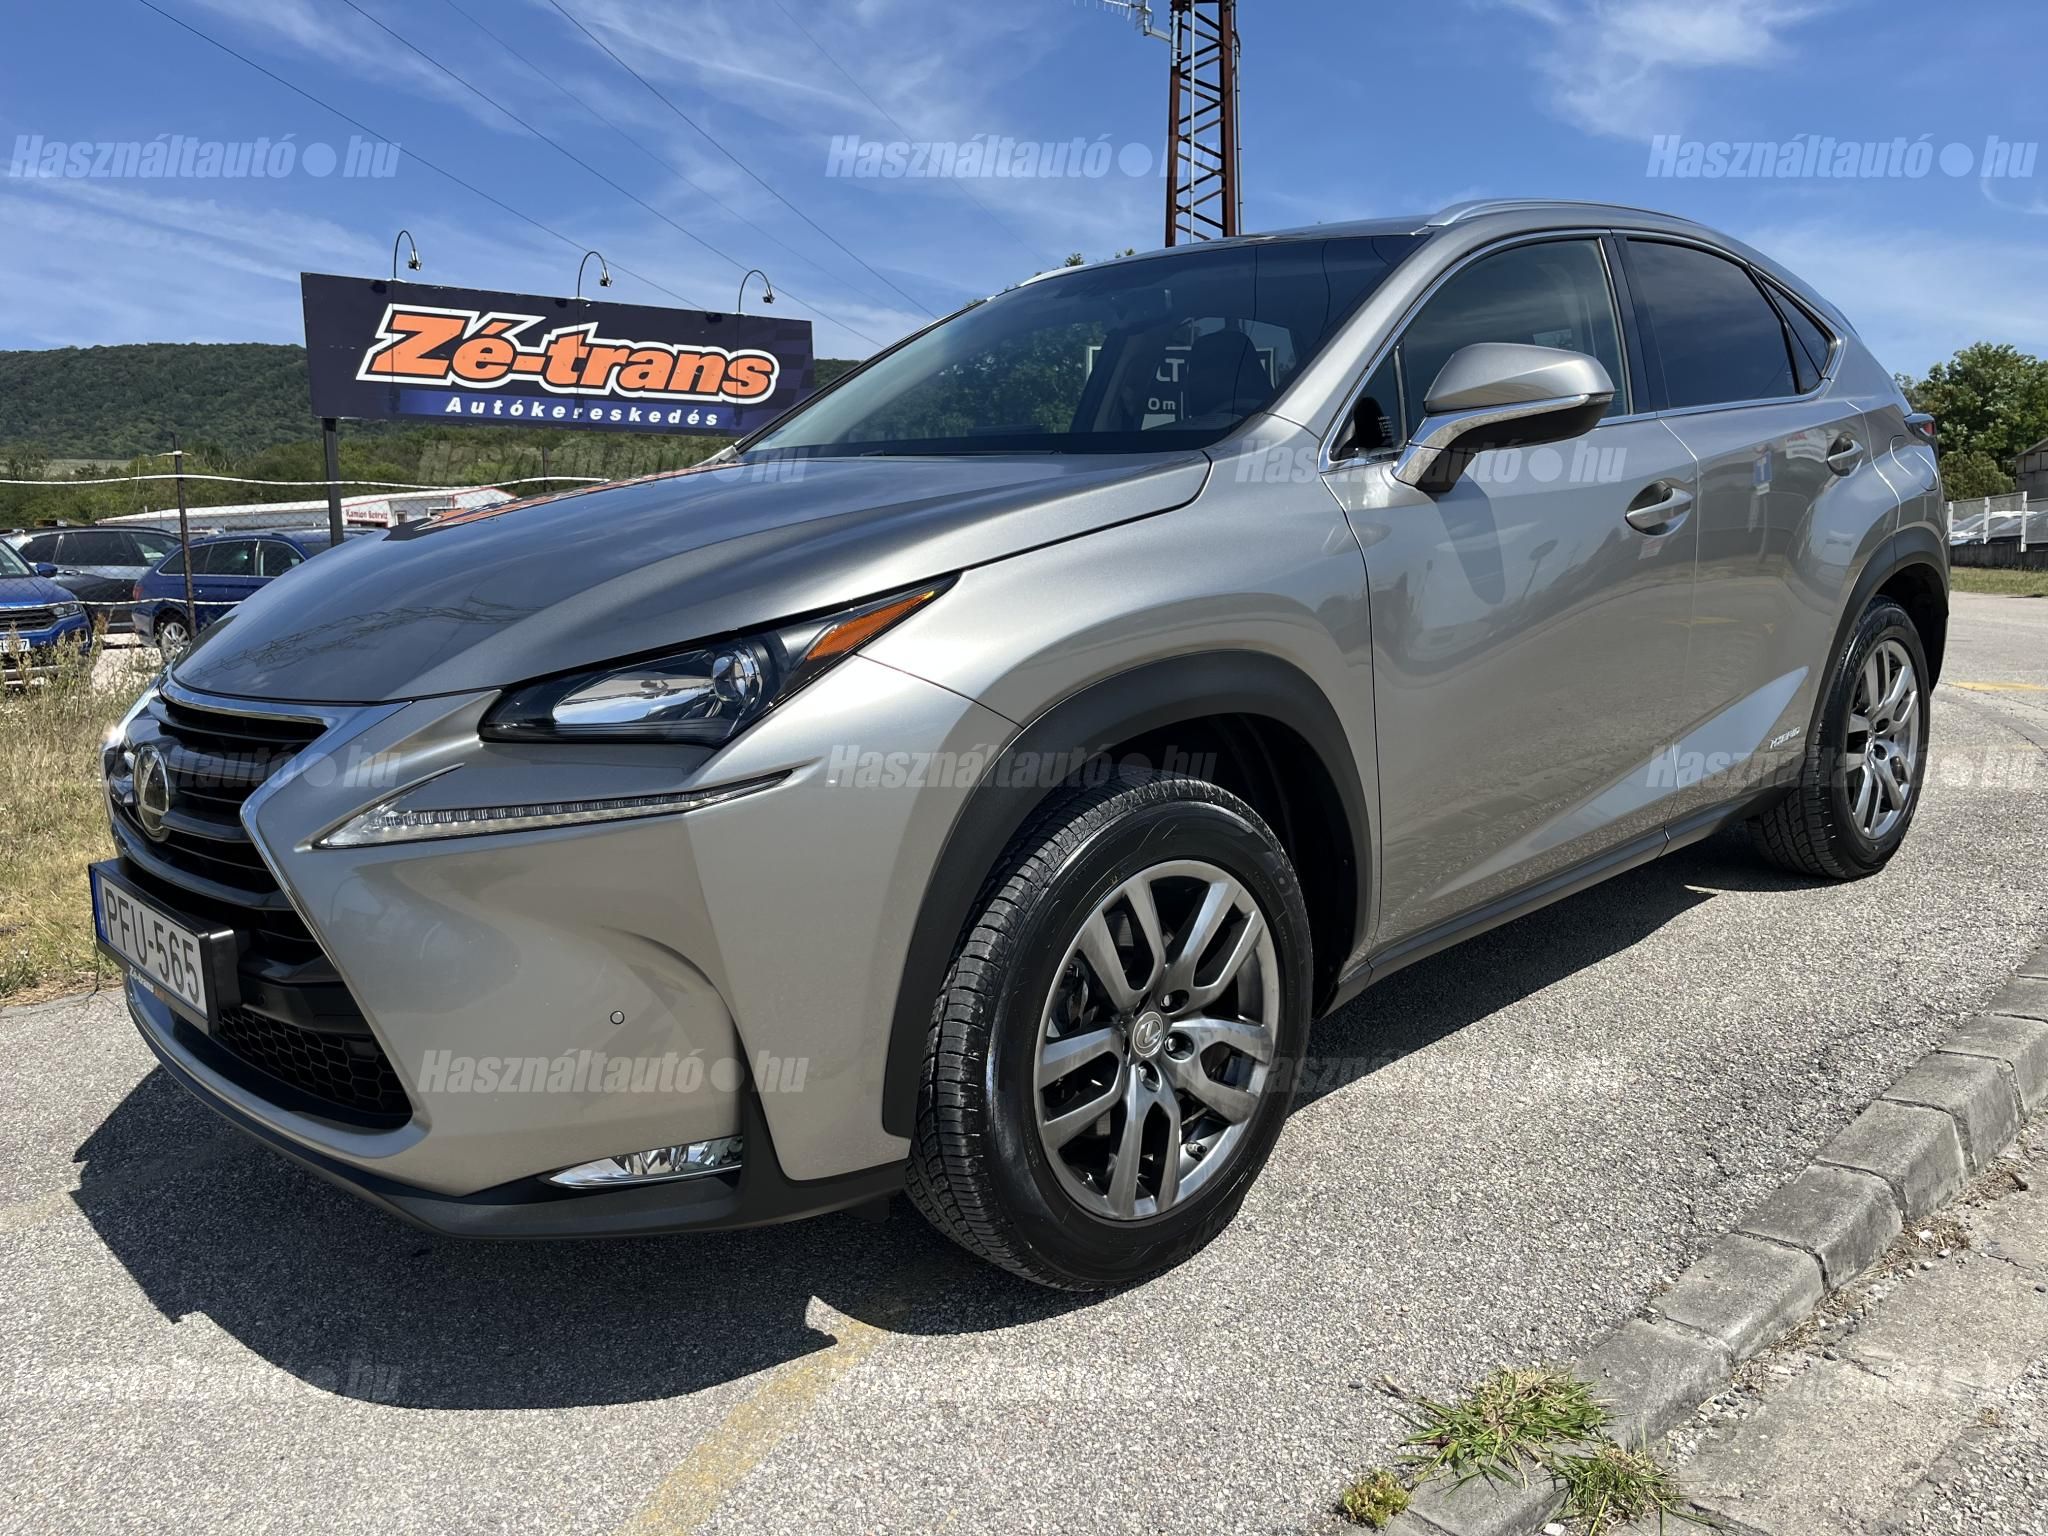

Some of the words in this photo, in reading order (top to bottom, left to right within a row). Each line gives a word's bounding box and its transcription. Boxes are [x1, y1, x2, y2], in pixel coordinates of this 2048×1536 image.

[357, 304, 779, 404] Zé-trans
[446, 396, 718, 426] Autókereskedés
[105, 886, 200, 1004] PFU-565
